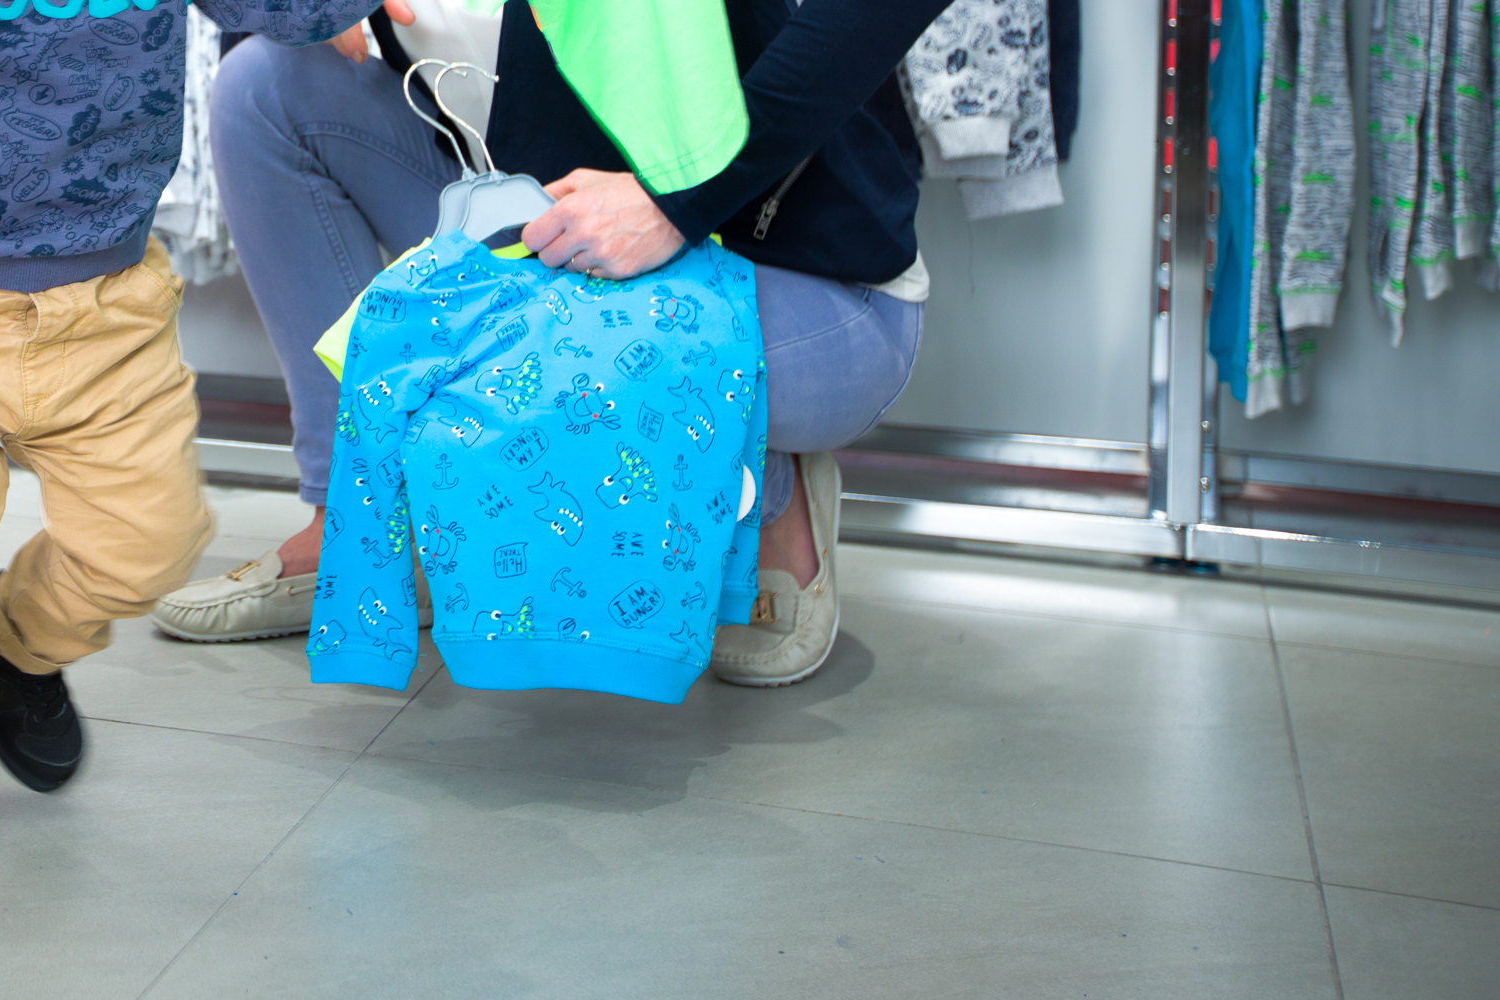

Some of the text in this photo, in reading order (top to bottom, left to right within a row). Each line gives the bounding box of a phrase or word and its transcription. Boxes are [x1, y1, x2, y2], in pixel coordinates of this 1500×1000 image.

[94, 22, 135, 43] TIGGER!
[146, 14, 172, 48] POW!
[106, 79, 130, 109] HELLO
[9, 117, 56, 138] TIGGER!
[73, 108, 99, 141] POW!
[15, 171, 46, 200] HELLO
[65, 184, 106, 200] BOOM!
[628, 344, 648, 362] AM
[515, 437, 546, 466] I AM
[477, 484, 502, 508] AWE
[484, 495, 515, 520] SOME
[496, 557, 523, 574] Hello
[613, 586, 650, 617] I AM
